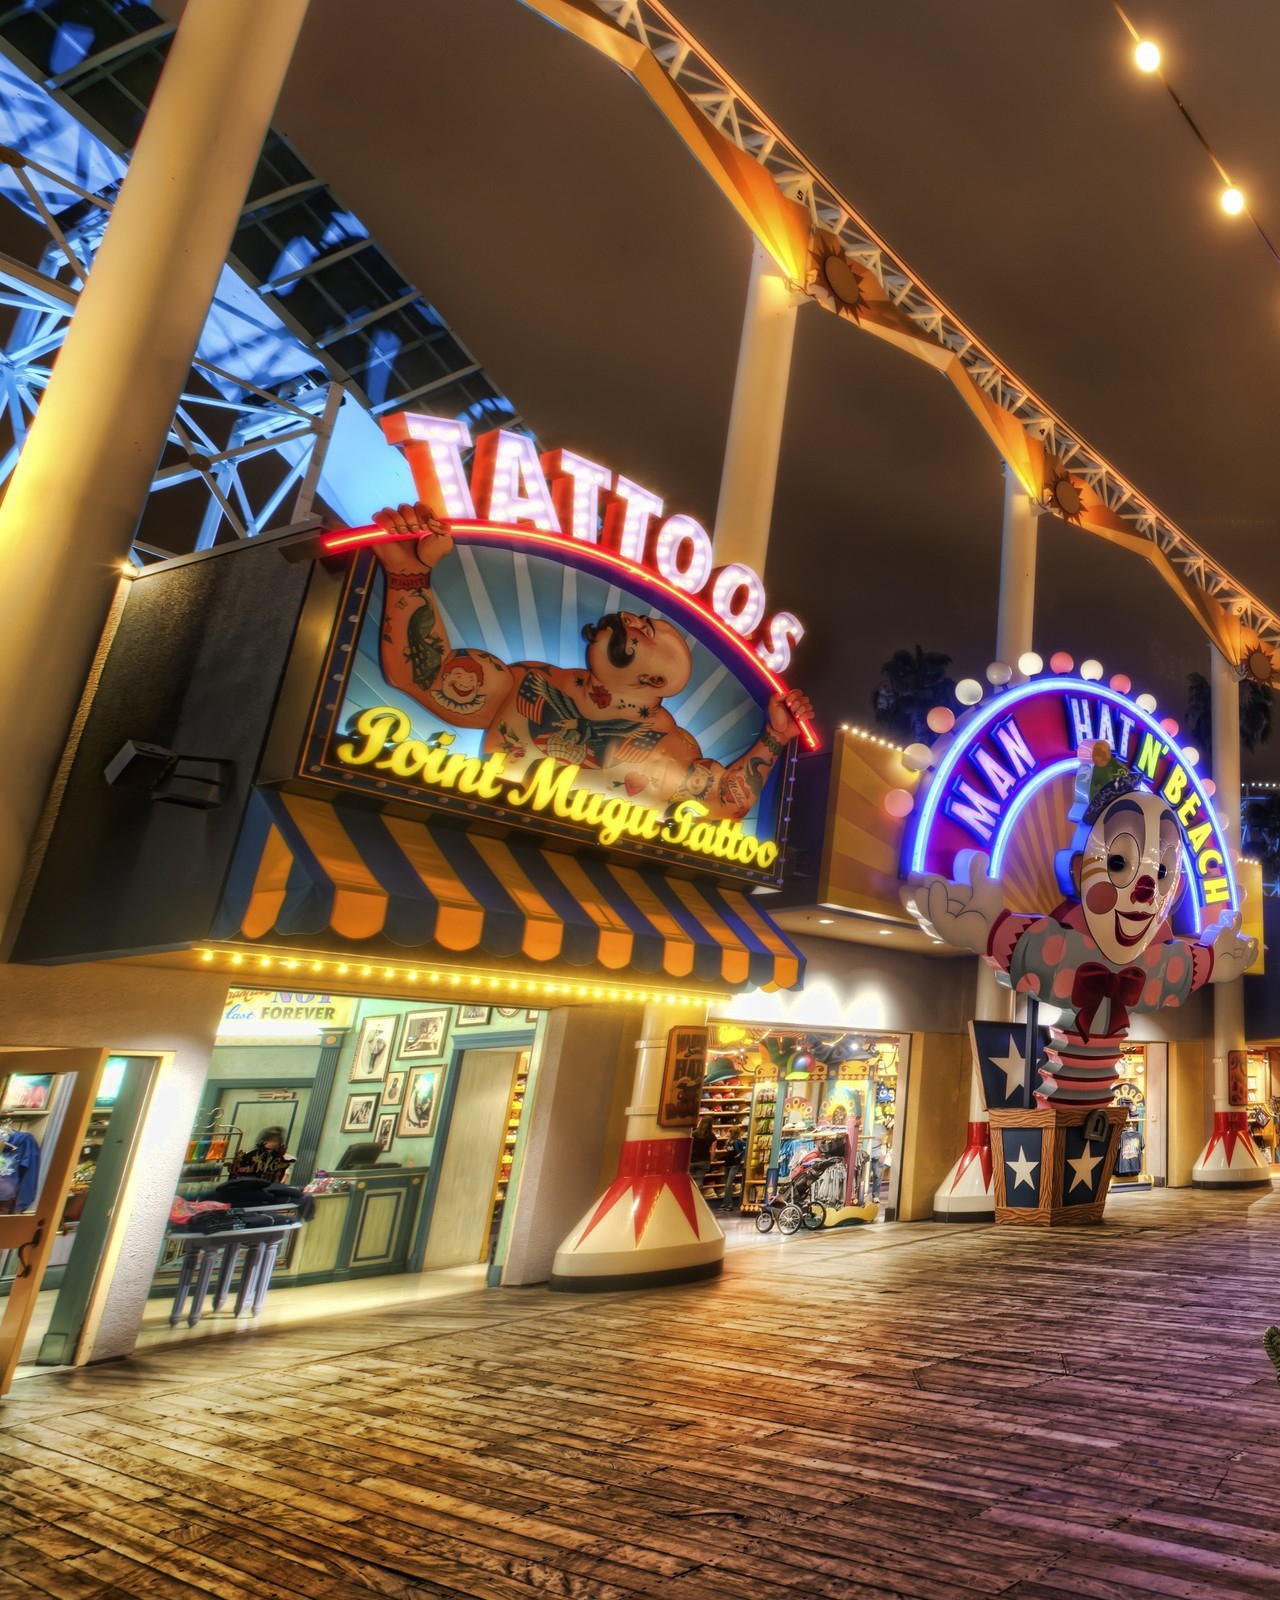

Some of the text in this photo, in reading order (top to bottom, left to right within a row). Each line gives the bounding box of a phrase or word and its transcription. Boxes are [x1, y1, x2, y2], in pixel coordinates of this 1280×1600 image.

[796, 189, 804, 201] 5
[379, 411, 805, 674] TATTOOS
[337, 706, 780, 869] Point Mugu Tattoo
[950, 719, 1036, 842] MAN
[1069, 696, 1136, 758] HAT
[1163, 764, 1230, 905] BEACH
[226, 1004, 336, 1020] last FOREVER
